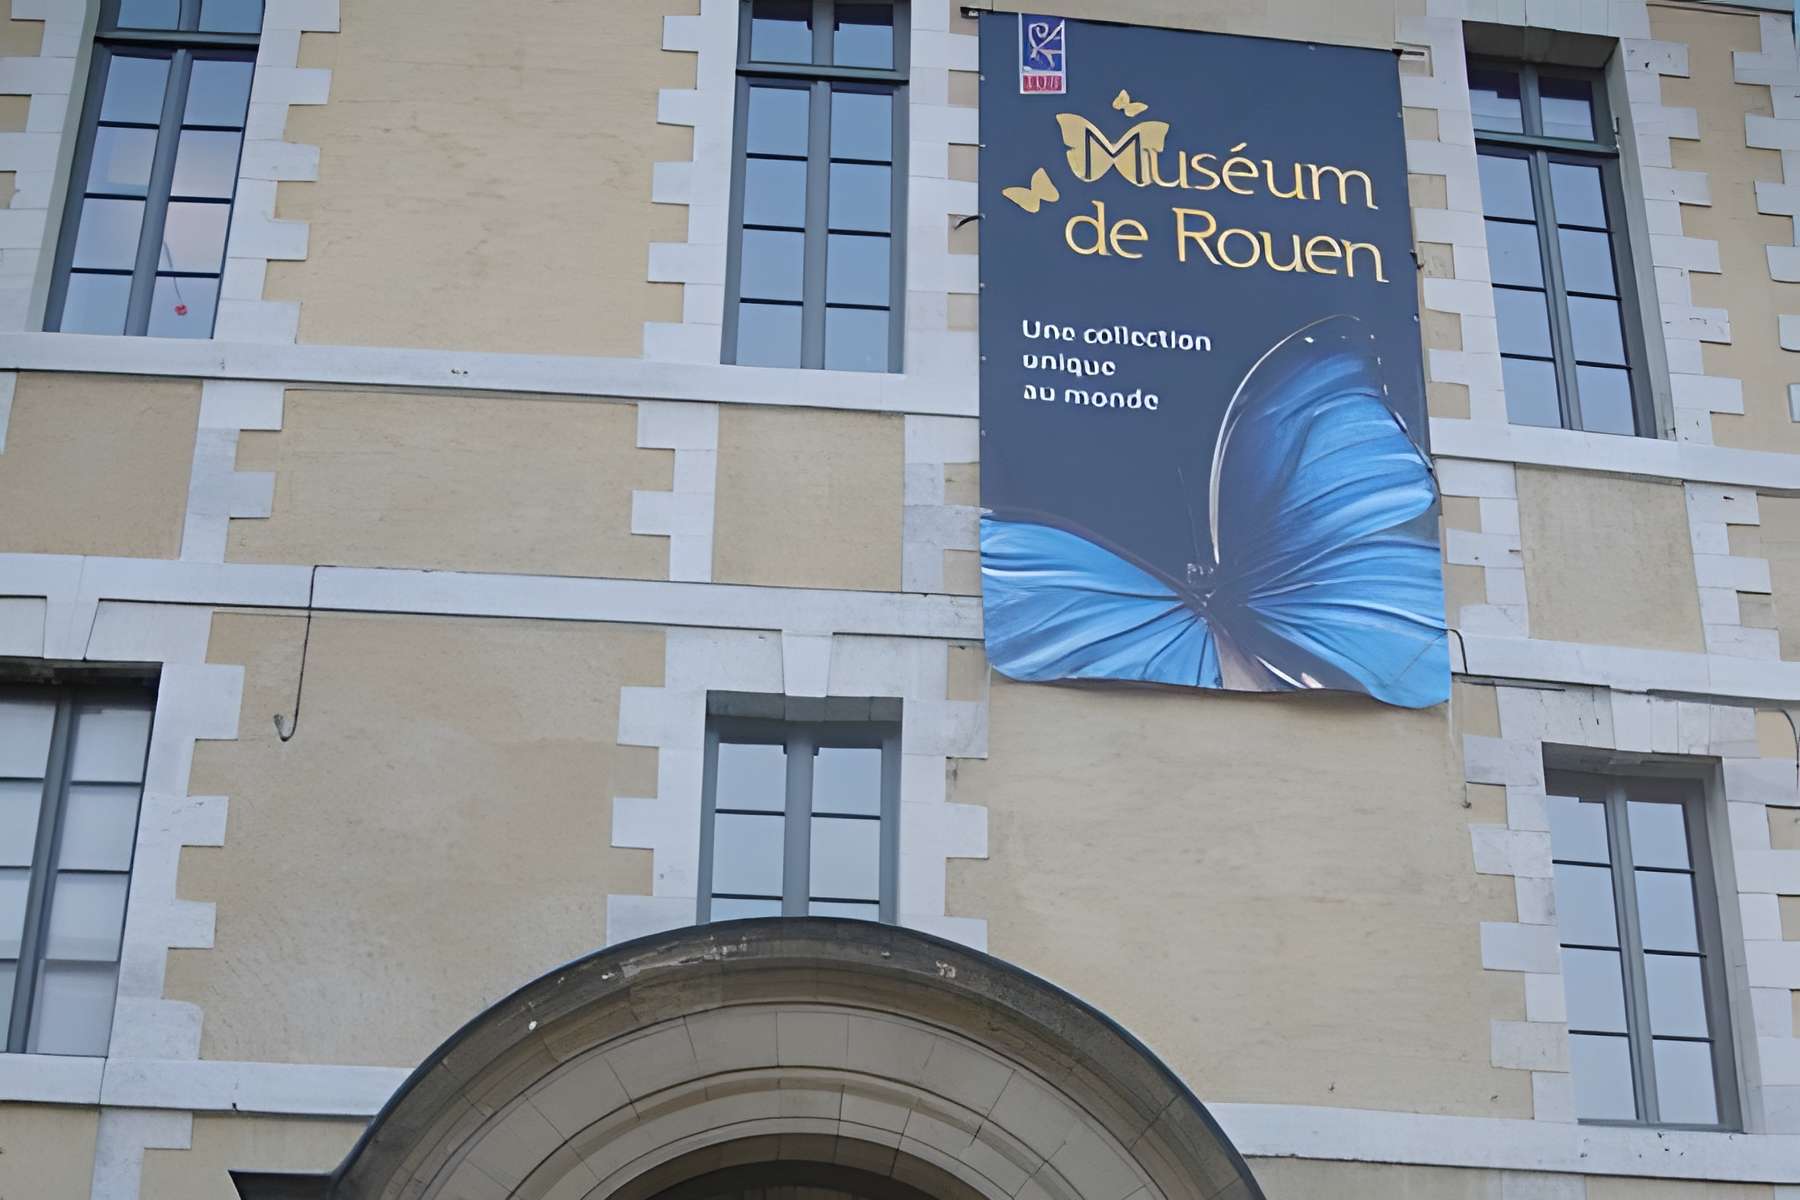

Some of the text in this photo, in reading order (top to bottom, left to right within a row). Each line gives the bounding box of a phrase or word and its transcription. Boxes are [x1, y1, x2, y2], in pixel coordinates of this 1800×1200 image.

[1056, 113, 1378, 210] Muséum
[1065, 200, 1390, 283] de Rouen
[1022, 319, 1212, 351] Une collection
[1022, 353, 1116, 377] unique
[1023, 384, 1159, 410] au monde
